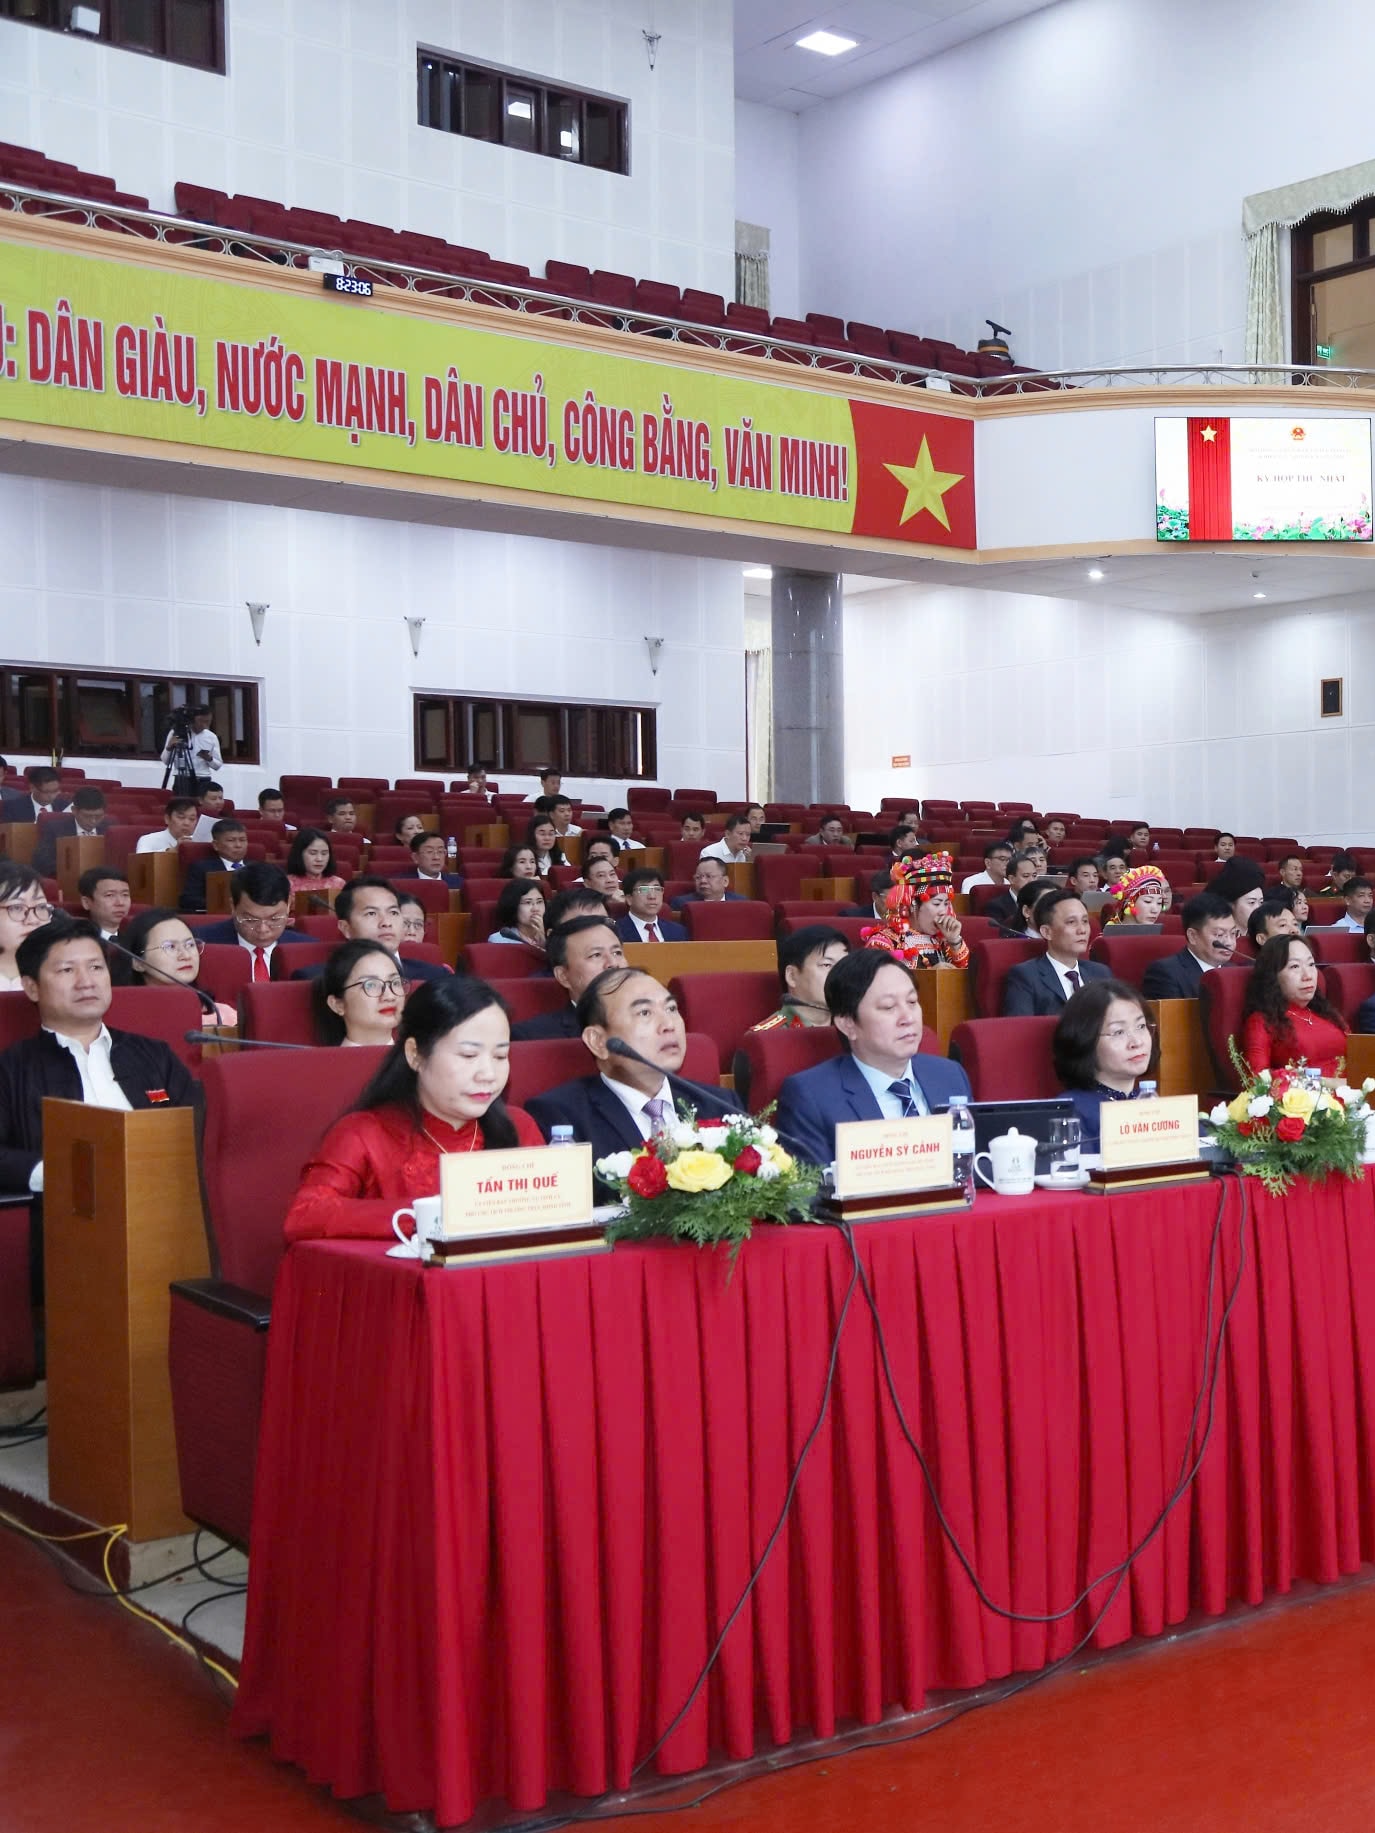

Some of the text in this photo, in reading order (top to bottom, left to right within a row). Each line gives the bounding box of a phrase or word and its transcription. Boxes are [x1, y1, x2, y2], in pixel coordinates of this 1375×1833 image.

[27, 298, 104, 392] DÂN
[115, 315, 206, 416] GIÀU,
[216, 336, 305, 421] NƯỚC
[315, 358, 415, 446] MẠNH,
[424, 366, 484, 447] DÂN
[493, 373, 555, 467] CHỦ,
[563, 390, 635, 471] CÔNG
[643, 393, 717, 490] BẰNG,
[724, 417, 773, 491] VĂN
[779, 436, 849, 502] MINH!
[508, 1178, 528, 1193] THỊ
